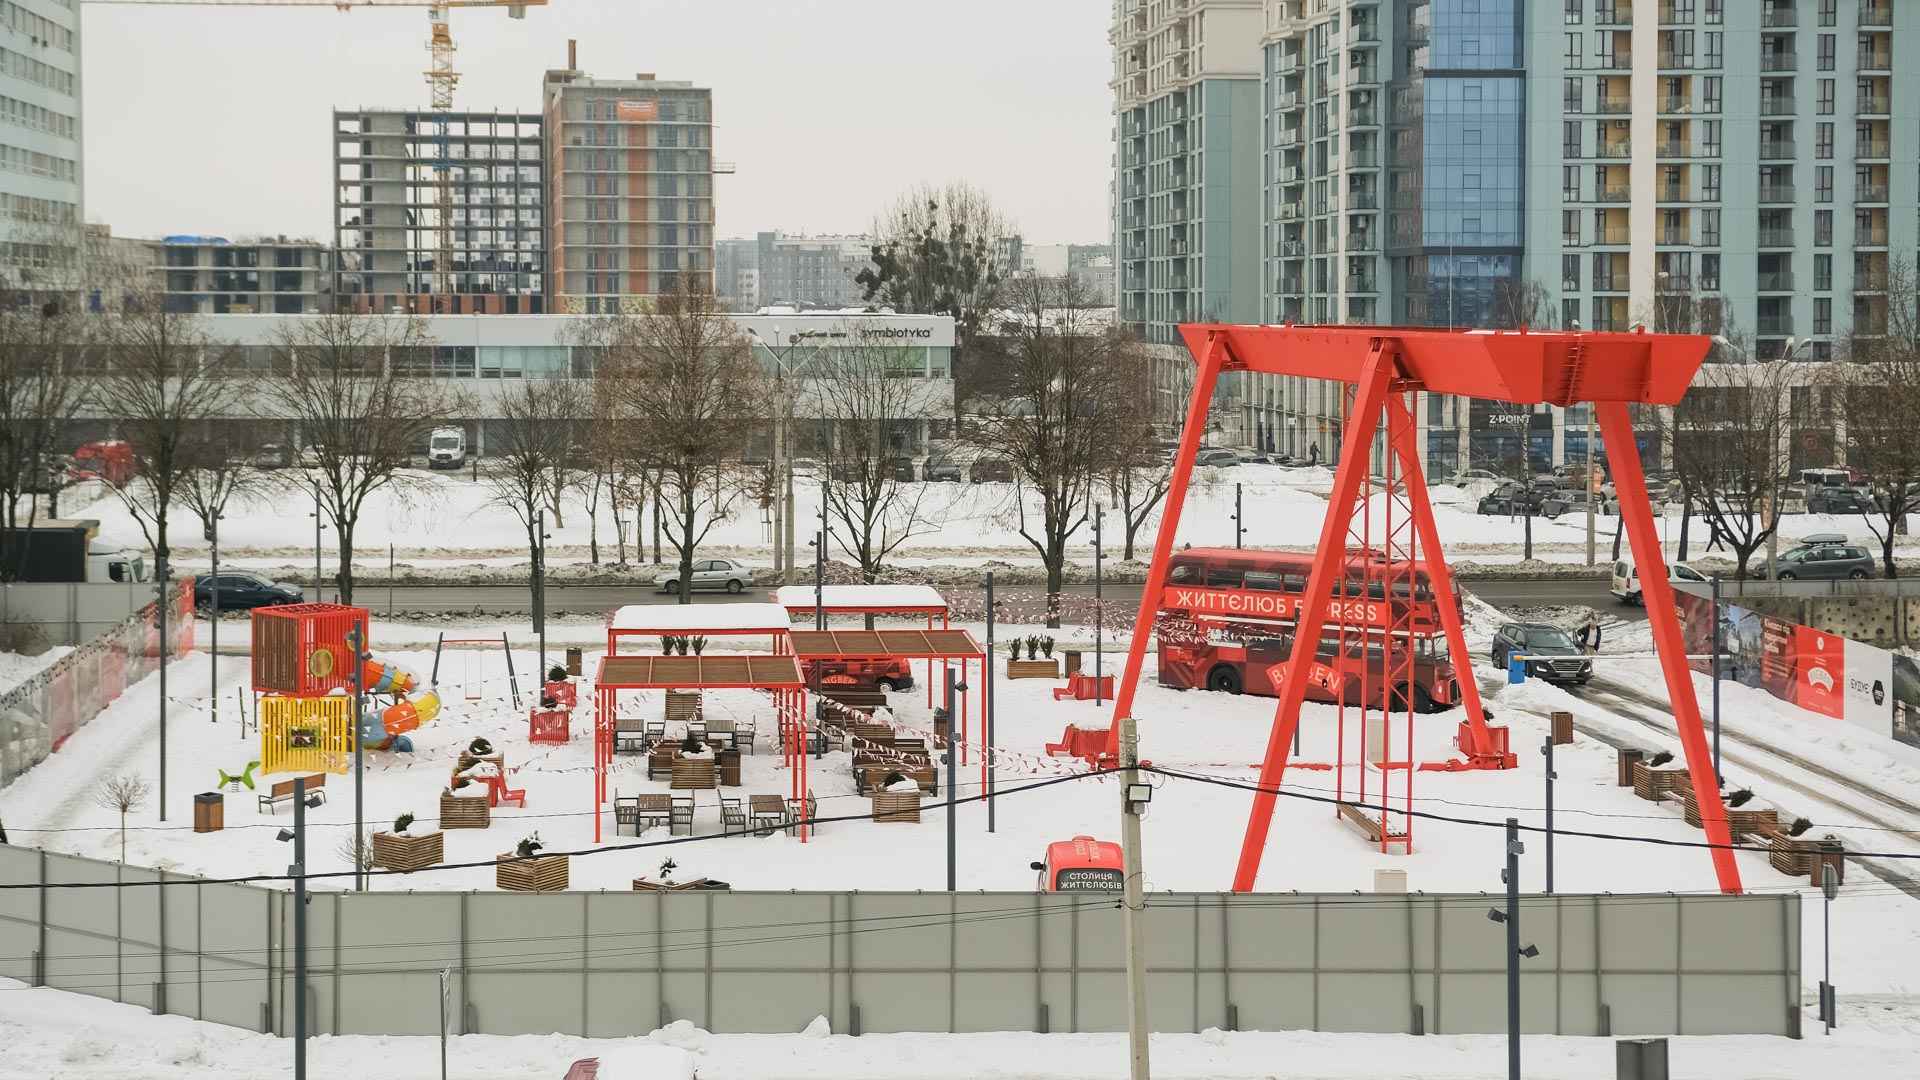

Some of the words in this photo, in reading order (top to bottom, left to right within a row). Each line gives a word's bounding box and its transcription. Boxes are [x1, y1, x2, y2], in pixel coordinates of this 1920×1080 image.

[1176, 590, 1287, 614] ЖИТТЄЛЮБ
[1069, 872, 1113, 881] СТОЛИЦЯ
[1061, 881, 1122, 889] ЖИТТЄЛЮБІВ
